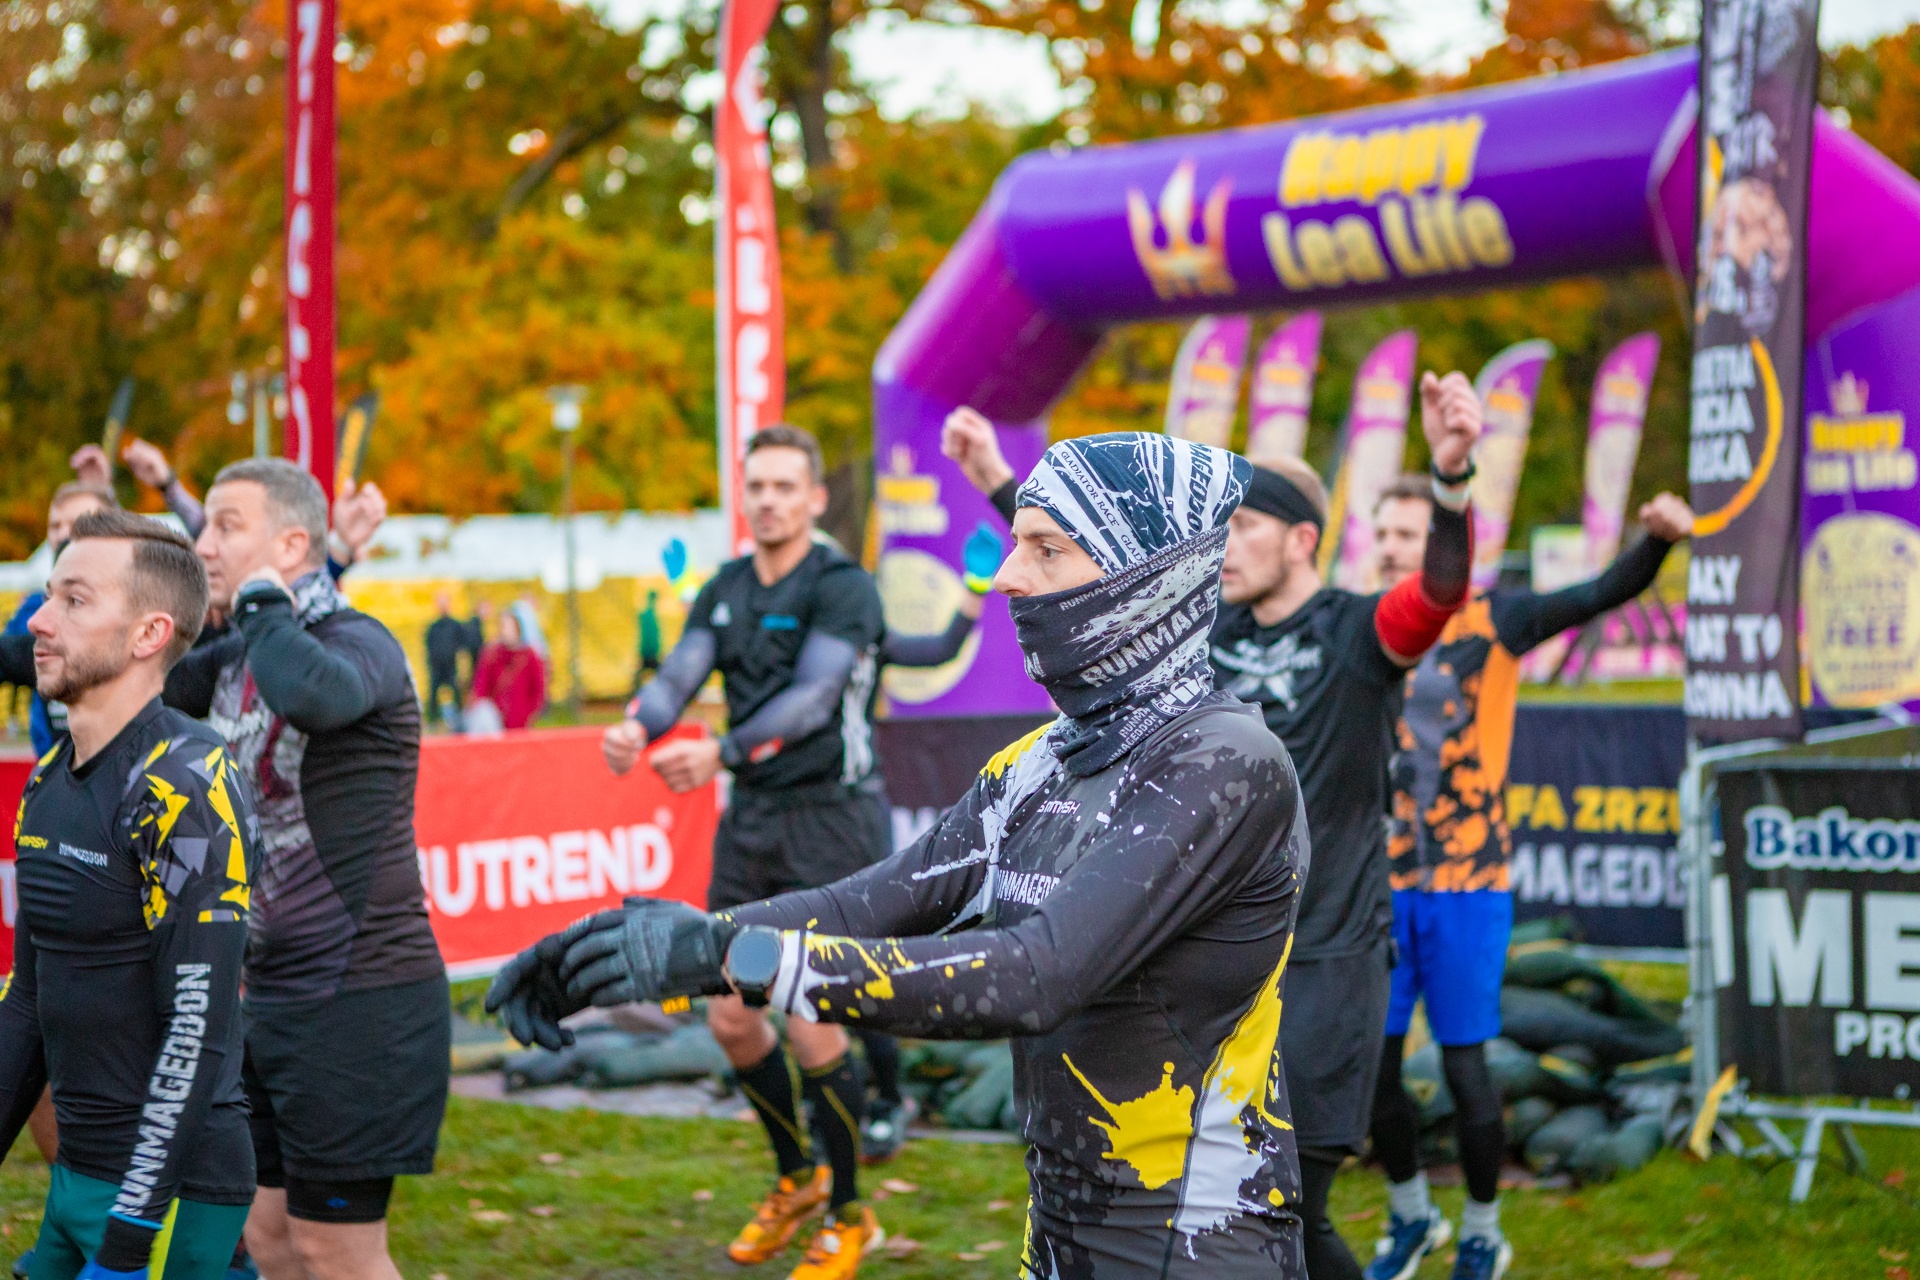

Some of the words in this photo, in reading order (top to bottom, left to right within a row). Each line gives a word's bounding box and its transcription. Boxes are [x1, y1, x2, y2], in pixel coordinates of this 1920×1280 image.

[1379, 193, 1514, 277] Life
[1060, 451, 1099, 501] GLADIATOR
[1096, 500, 1118, 527] RACE
[1059, 563, 1149, 611] RUNMAGEDDON
